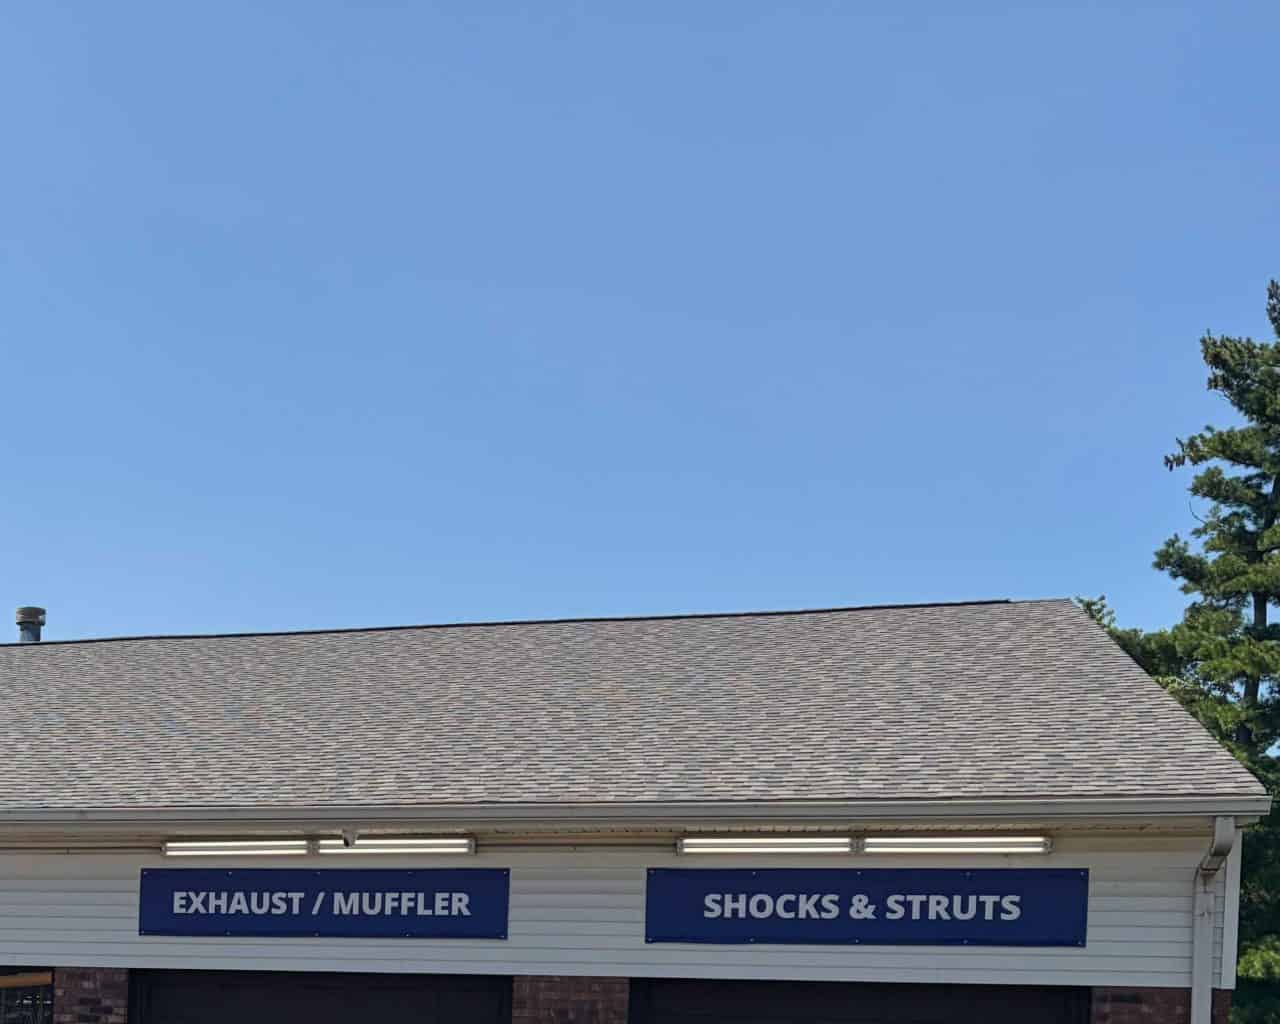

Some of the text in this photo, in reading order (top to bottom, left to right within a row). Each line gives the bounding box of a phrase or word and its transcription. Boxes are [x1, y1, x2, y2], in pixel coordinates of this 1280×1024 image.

[173, 891, 471, 916] EXHAUST / MUFFLER
[704, 894, 1021, 920] SHOCKS & STRUTS
